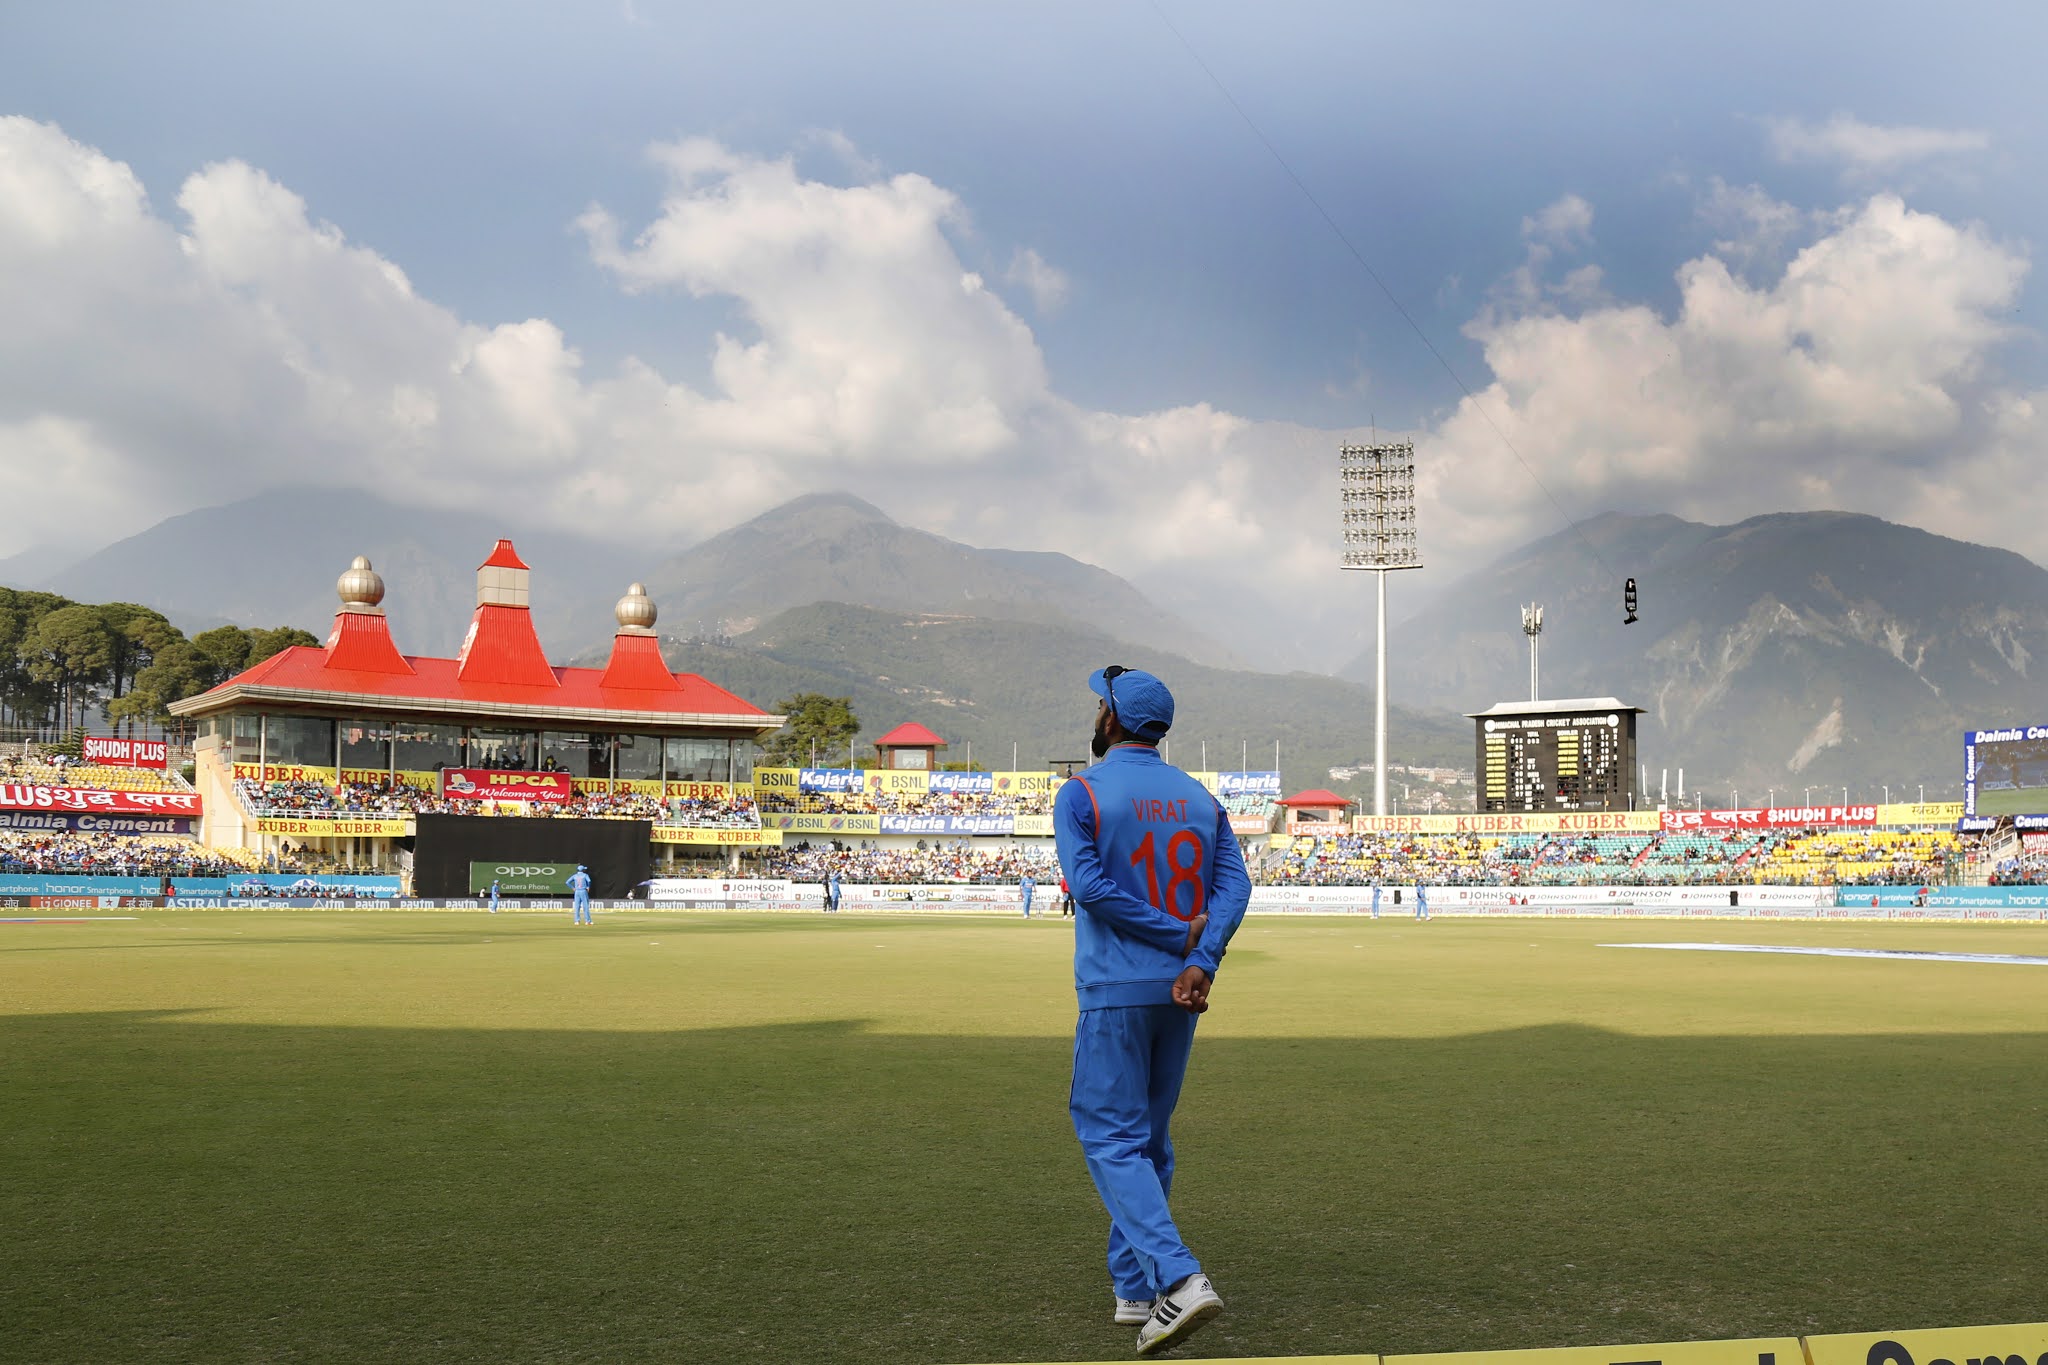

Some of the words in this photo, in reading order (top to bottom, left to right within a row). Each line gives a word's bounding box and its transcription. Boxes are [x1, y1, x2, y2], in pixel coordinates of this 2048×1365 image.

[1521, 720, 1545, 728] PRADESH
[1546, 718, 1570, 727] CRICKET
[1572, 717, 1607, 726] ASSOCIATION
[1975, 728, 2023, 743] Dalmia
[85, 739, 130, 759] SHUDH
[134, 742, 166, 761] PLUS
[1966, 745, 1975, 781] Cement
[234, 765, 303, 781] KUBER
[306, 771, 336, 783] VILAS
[340, 770, 405, 787] KUBER
[406, 776, 435, 787] VILAS
[489, 774, 558, 787] HPCA
[762, 773, 796, 786] BSNL
[801, 771, 863, 788] Kajaria
[570, 780, 632, 796] KUBER
[633, 785, 661, 793] VILAS
[892, 776, 925, 788] BSNL
[930, 774, 992, 791] Kajaria
[1219, 775, 1280, 791] Kajaria
[476, 788, 536, 799] Welcomes
[540, 790, 565, 799] You
[666, 783, 725, 798] KUBER
[1966, 783, 1975, 815] Dalmia
[1132, 797, 1188, 822] VIRAT
[1767, 808, 1825, 823] SHUDH
[1831, 806, 1874, 821] PLUS
[78, 815, 175, 832] Cement
[258, 821, 308, 833] KUBER
[334, 823, 382, 833] KUBER
[797, 818, 826, 828] BSNL
[848, 819, 876, 829] BSNL
[882, 817, 945, 833] Kajaria
[951, 817, 1014, 833] Kajaria
[1017, 820, 1045, 830] BSNL
[1357, 817, 1422, 831] KUBER
[1456, 815, 1523, 831] KUBER
[1558, 814, 1627, 829] KUBER
[1963, 817, 1996, 829] Dalmia
[650, 829, 694, 840] KUBER
[718, 831, 761, 842] KUBER
[495, 866, 556, 877] oppo
[1130, 829, 1204, 921] 18
[46, 883, 85, 893] honor
[87, 886, 134, 895] Smartphone
[180, 888, 223, 896] Smartphone
[355, 885, 397, 893] Smartphone
[733, 884, 785, 892] JOHNSON
[53, 899, 92, 908] GIONEE
[165, 899, 220, 909] ASTRAL
[1960, 897, 2003, 906] Smartphone
[2009, 894, 2044, 904] honor
